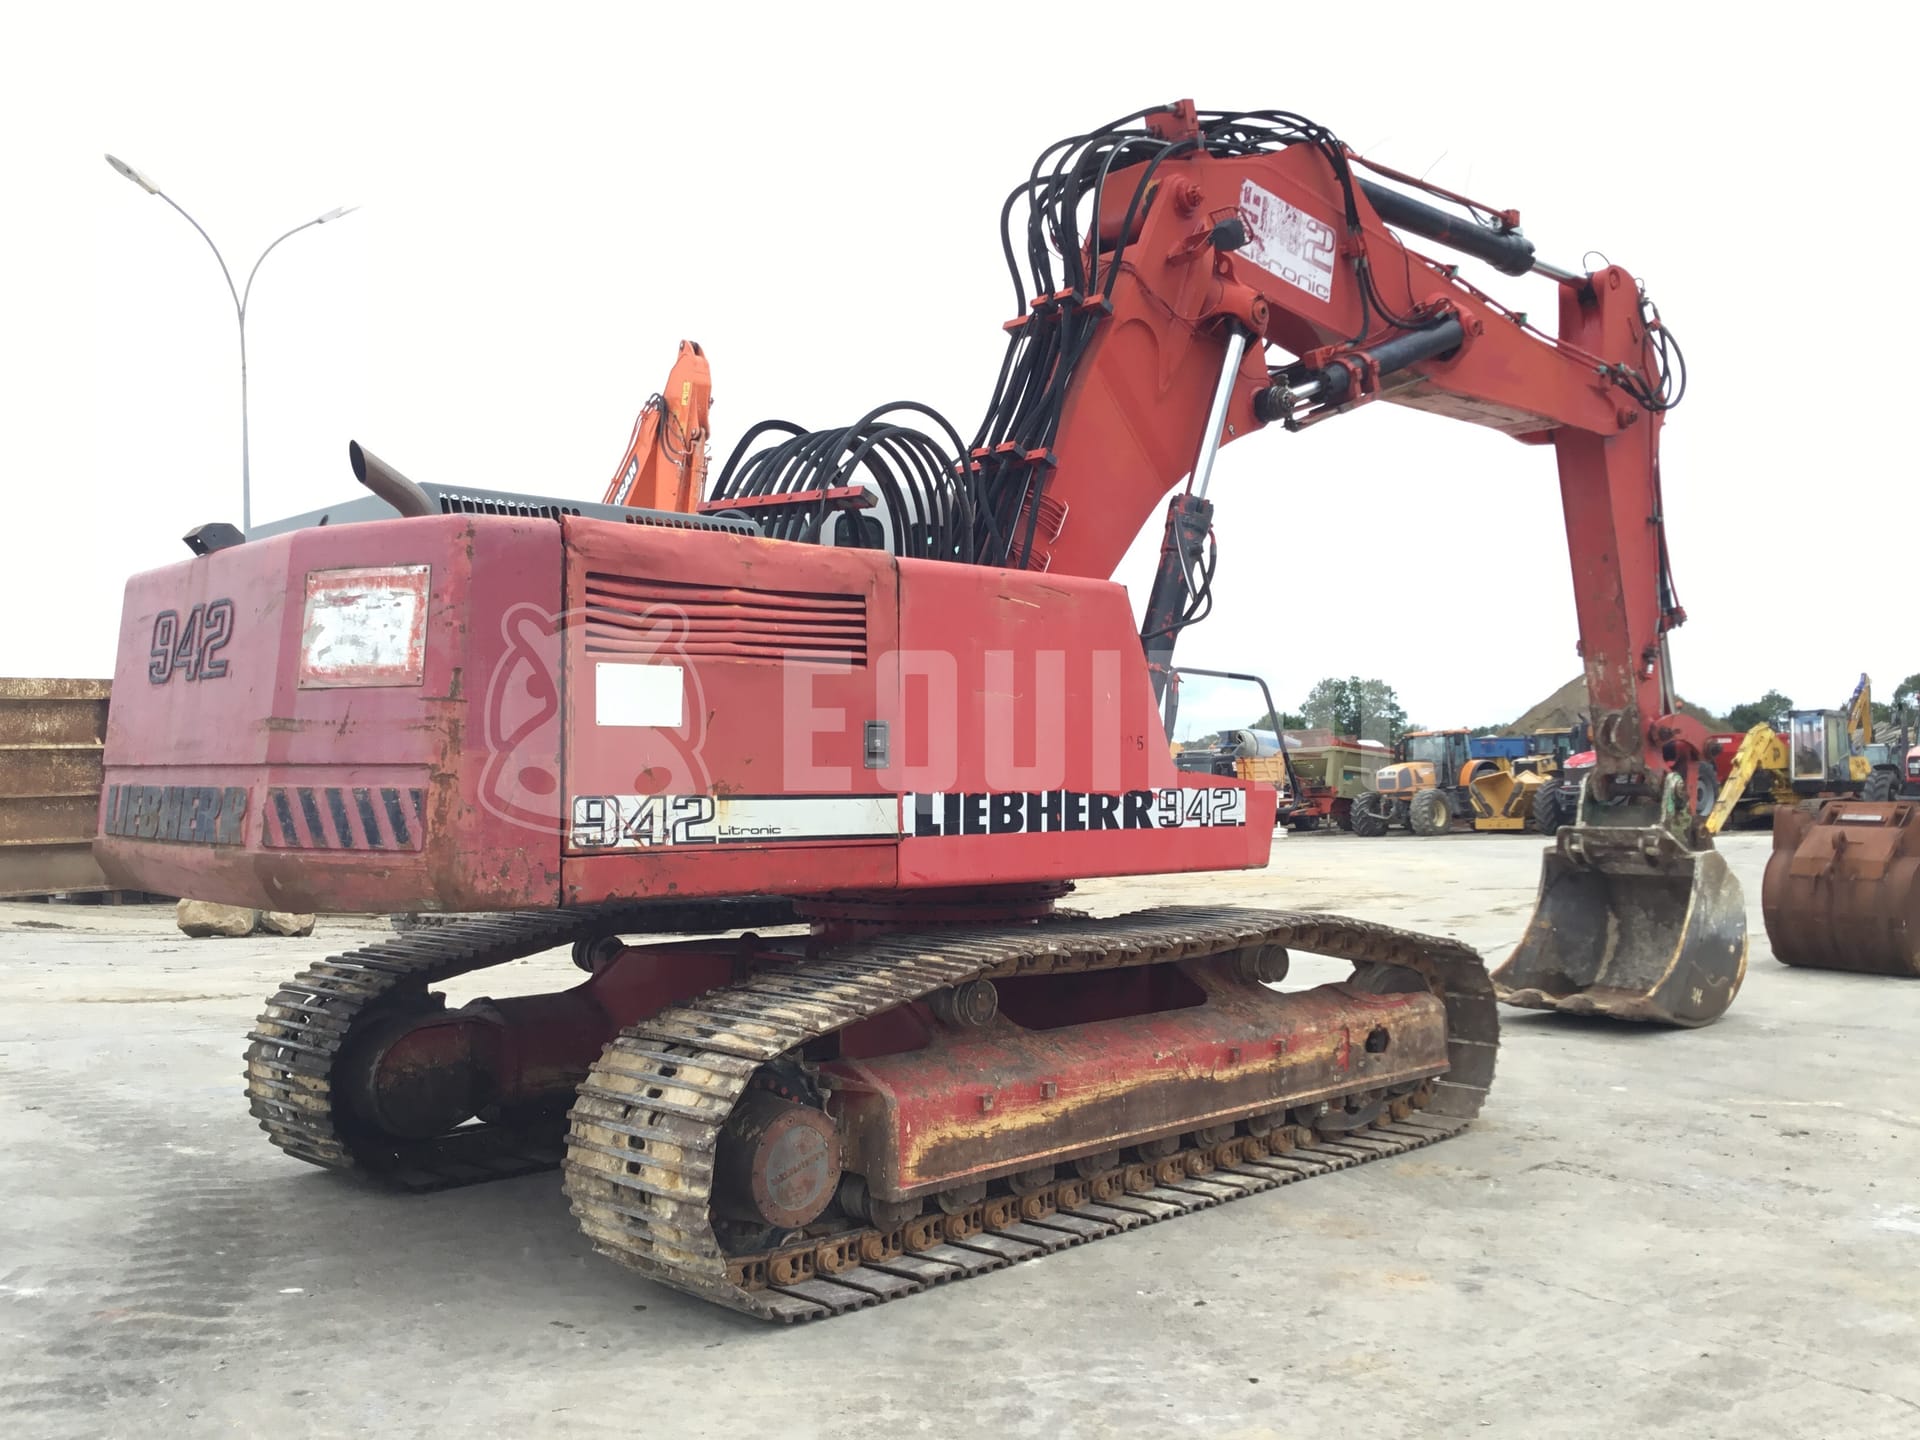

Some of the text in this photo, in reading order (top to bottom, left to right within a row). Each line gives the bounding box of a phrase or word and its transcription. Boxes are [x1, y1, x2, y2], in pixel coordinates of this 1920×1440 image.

[1241, 184, 1336, 274] 92
[149, 598, 234, 684] 942
[104, 783, 248, 846] LIEBHERR
[572, 794, 782, 848] 942 Litronic
[915, 787, 1238, 837] LIEBHERR 942
